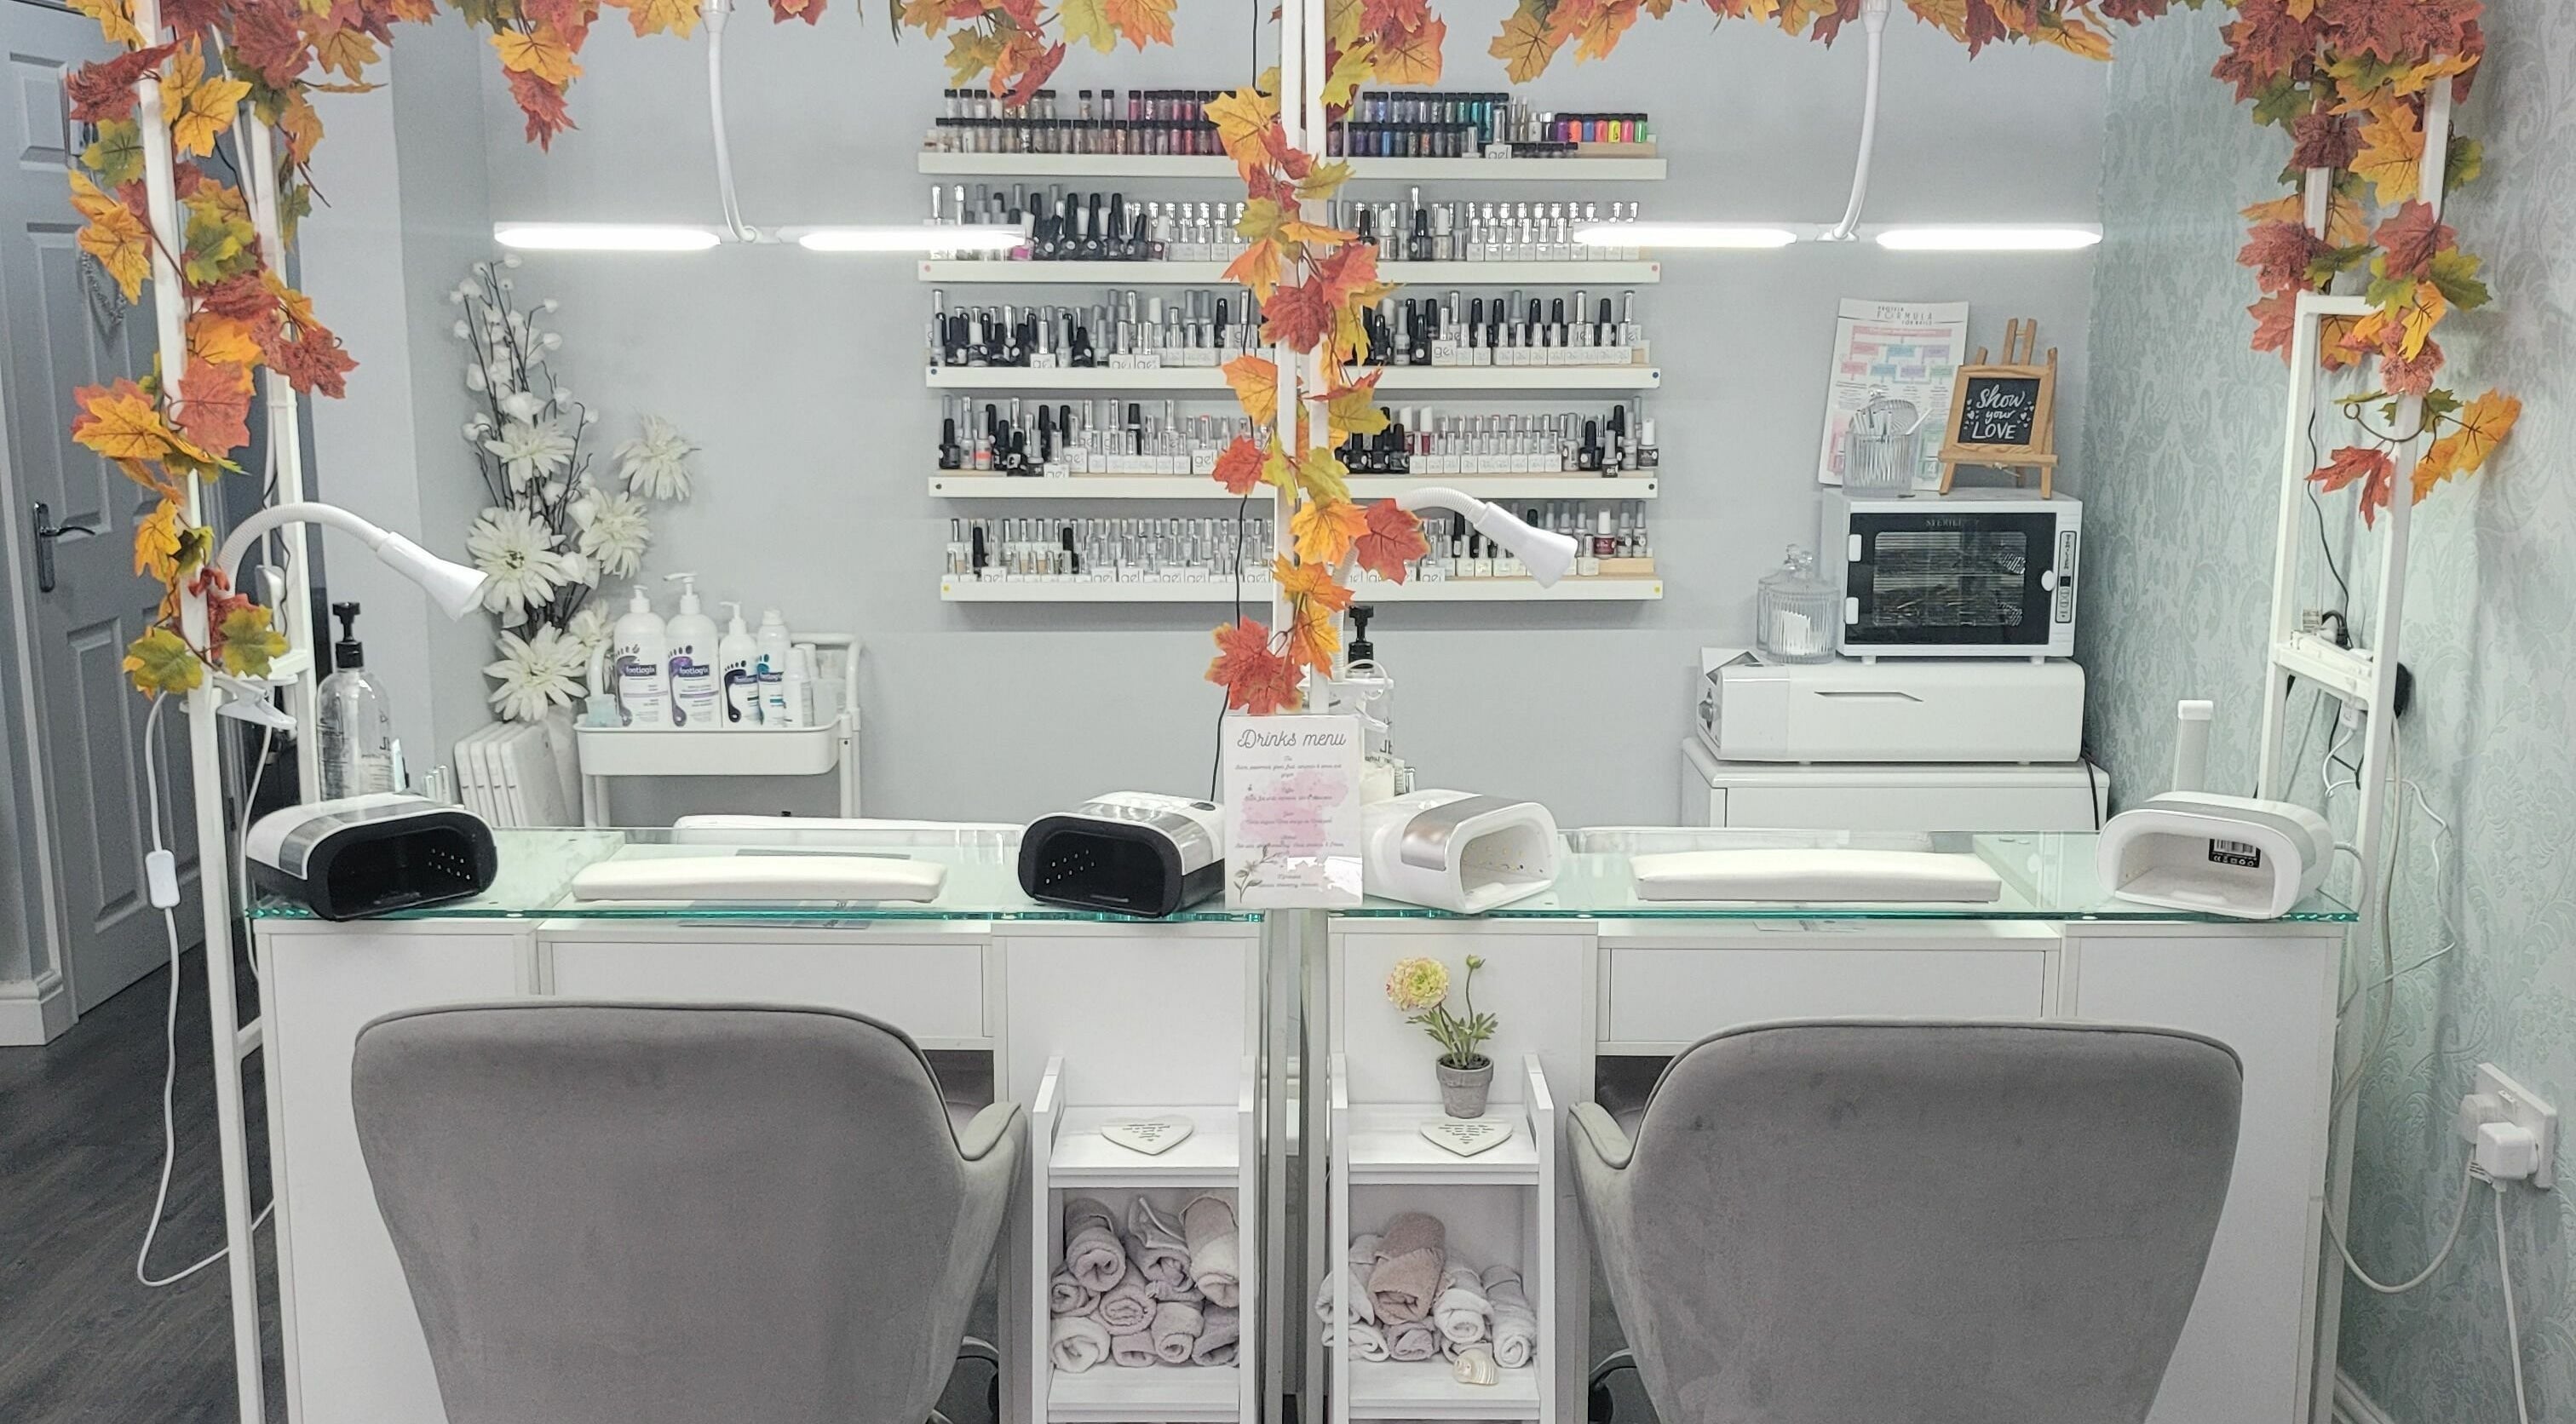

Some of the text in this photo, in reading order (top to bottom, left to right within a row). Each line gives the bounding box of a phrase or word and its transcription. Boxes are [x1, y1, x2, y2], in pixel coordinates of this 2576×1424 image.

[1876, 310, 1933, 321] FORMULA
[1976, 384, 2026, 409] Show
[1985, 410, 2015, 424] your
[1971, 421, 2017, 439] LOVE
[1236, 729, 1348, 749] Drinks menu
